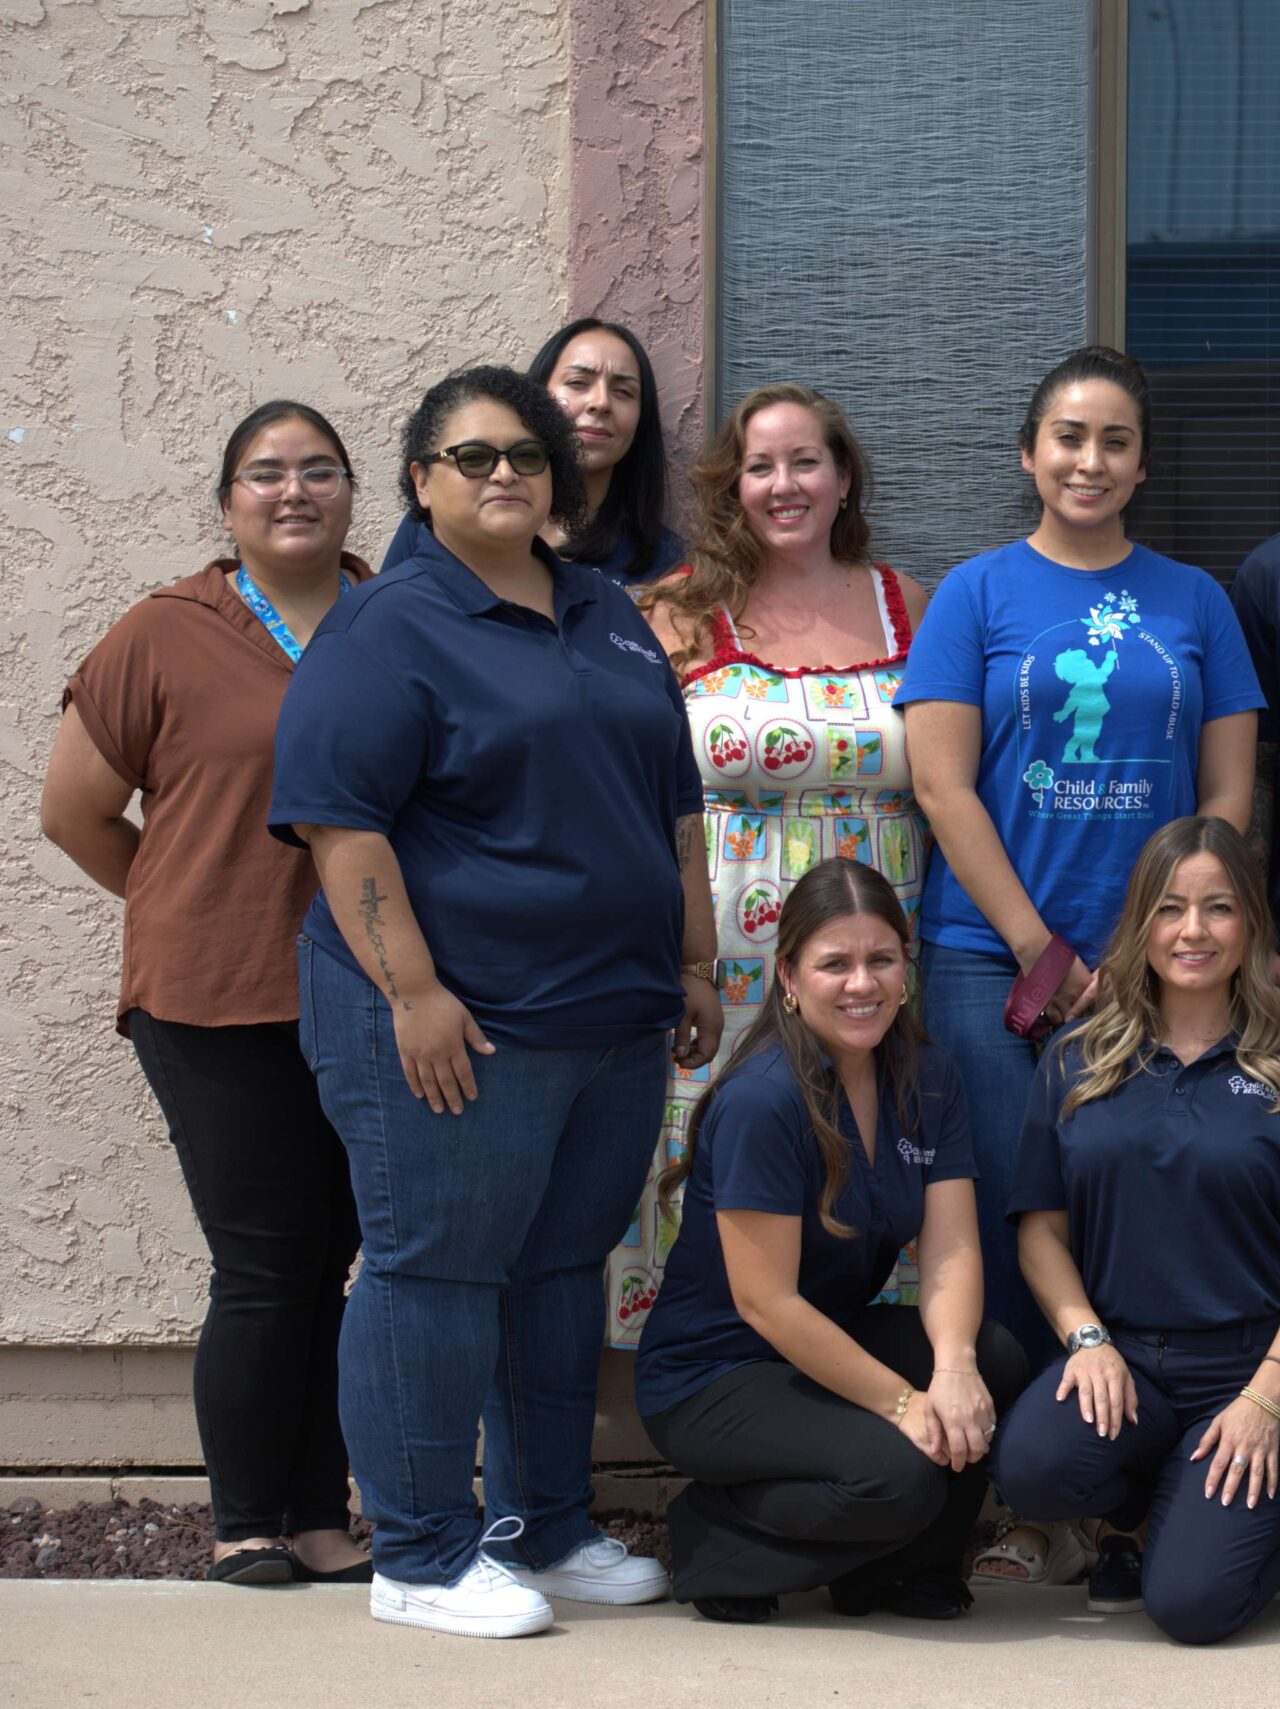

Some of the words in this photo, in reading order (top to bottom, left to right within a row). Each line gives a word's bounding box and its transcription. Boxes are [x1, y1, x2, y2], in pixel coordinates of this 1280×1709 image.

[1138, 632, 1165, 655] STAND
[1020, 654, 1036, 675] KIDS
[1162, 654, 1174, 665] UP
[1020, 675, 1029, 688] BE
[1169, 666, 1179, 679] TO
[1020, 689, 1030, 711] KIDS
[1172, 680, 1181, 709] CHILD
[1022, 713, 1031, 730] LET
[1166, 710, 1178, 740] ABUSE
[1054, 779, 1095, 795] Child
[1098, 784, 1106, 794] &
[1109, 779, 1153, 797] Family
[1054, 796, 1142, 810] RESOURCES
